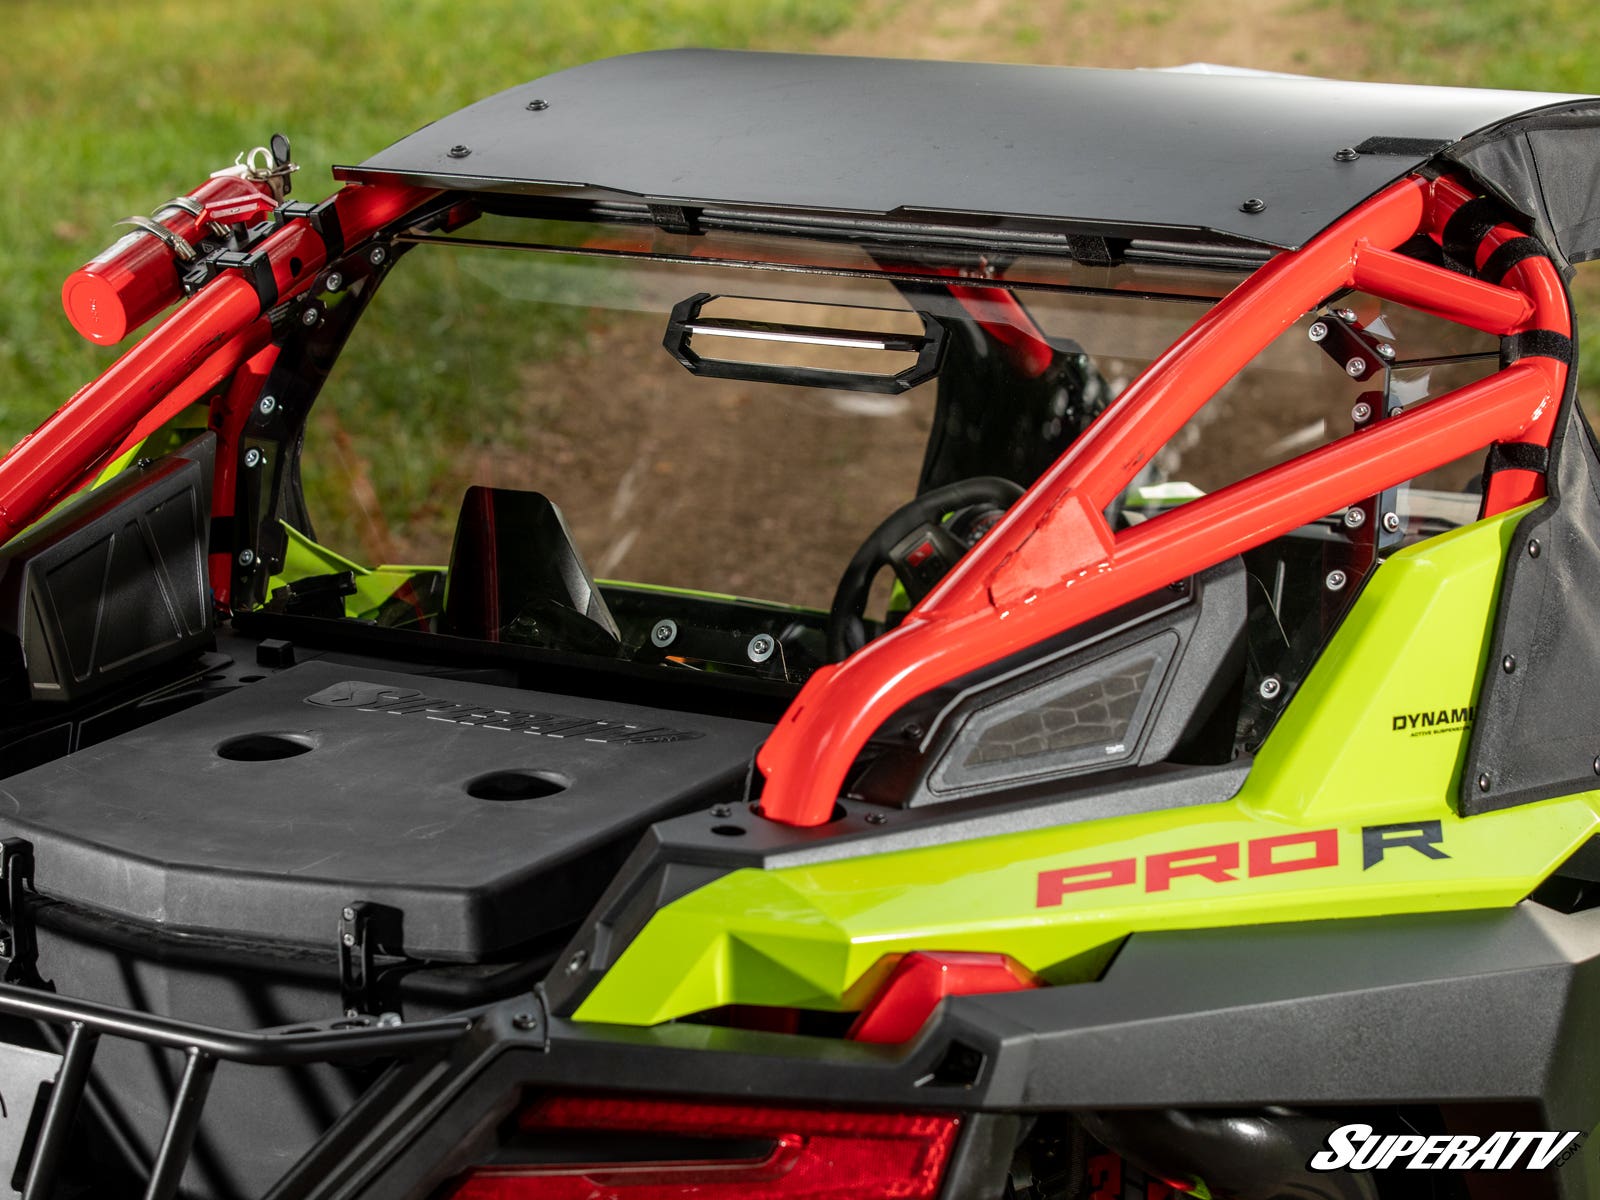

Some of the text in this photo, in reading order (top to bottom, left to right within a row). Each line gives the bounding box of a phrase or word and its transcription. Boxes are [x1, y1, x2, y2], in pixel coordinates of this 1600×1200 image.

[1392, 706, 1474, 731] DYNAMI
[1036, 820, 1451, 908] PRO R
